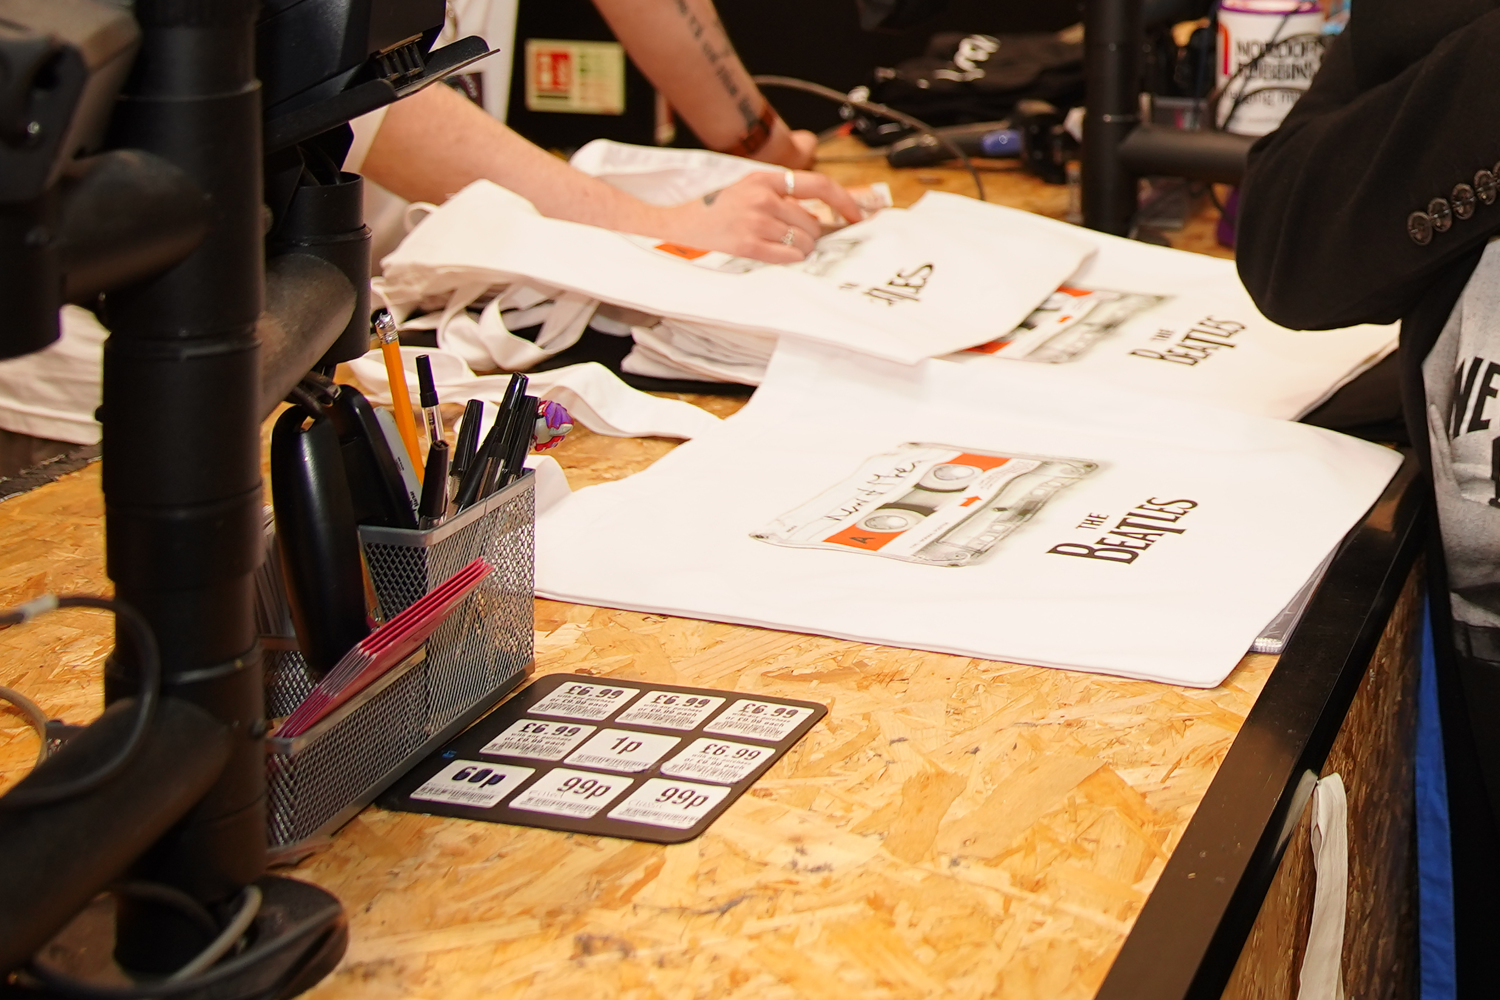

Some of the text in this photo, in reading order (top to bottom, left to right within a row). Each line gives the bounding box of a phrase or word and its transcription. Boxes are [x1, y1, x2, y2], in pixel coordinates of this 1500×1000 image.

[1127, 316, 1246, 367] BEATLES
[1149, 328, 1175, 342] THE
[1075, 512, 1110, 530] THE
[1046, 497, 1199, 565] BEATLES
[565, 685, 624, 699] £6.99
[651, 694, 711, 708] £6.99
[738, 702, 799, 718] £6.99
[519, 722, 581, 737] £6.99
[610, 736, 643, 755] 1p
[699, 743, 762, 760] £6.99
[452, 766, 506, 789] 60p
[557, 776, 612, 800] 99p
[655, 787, 710, 810] 99p
